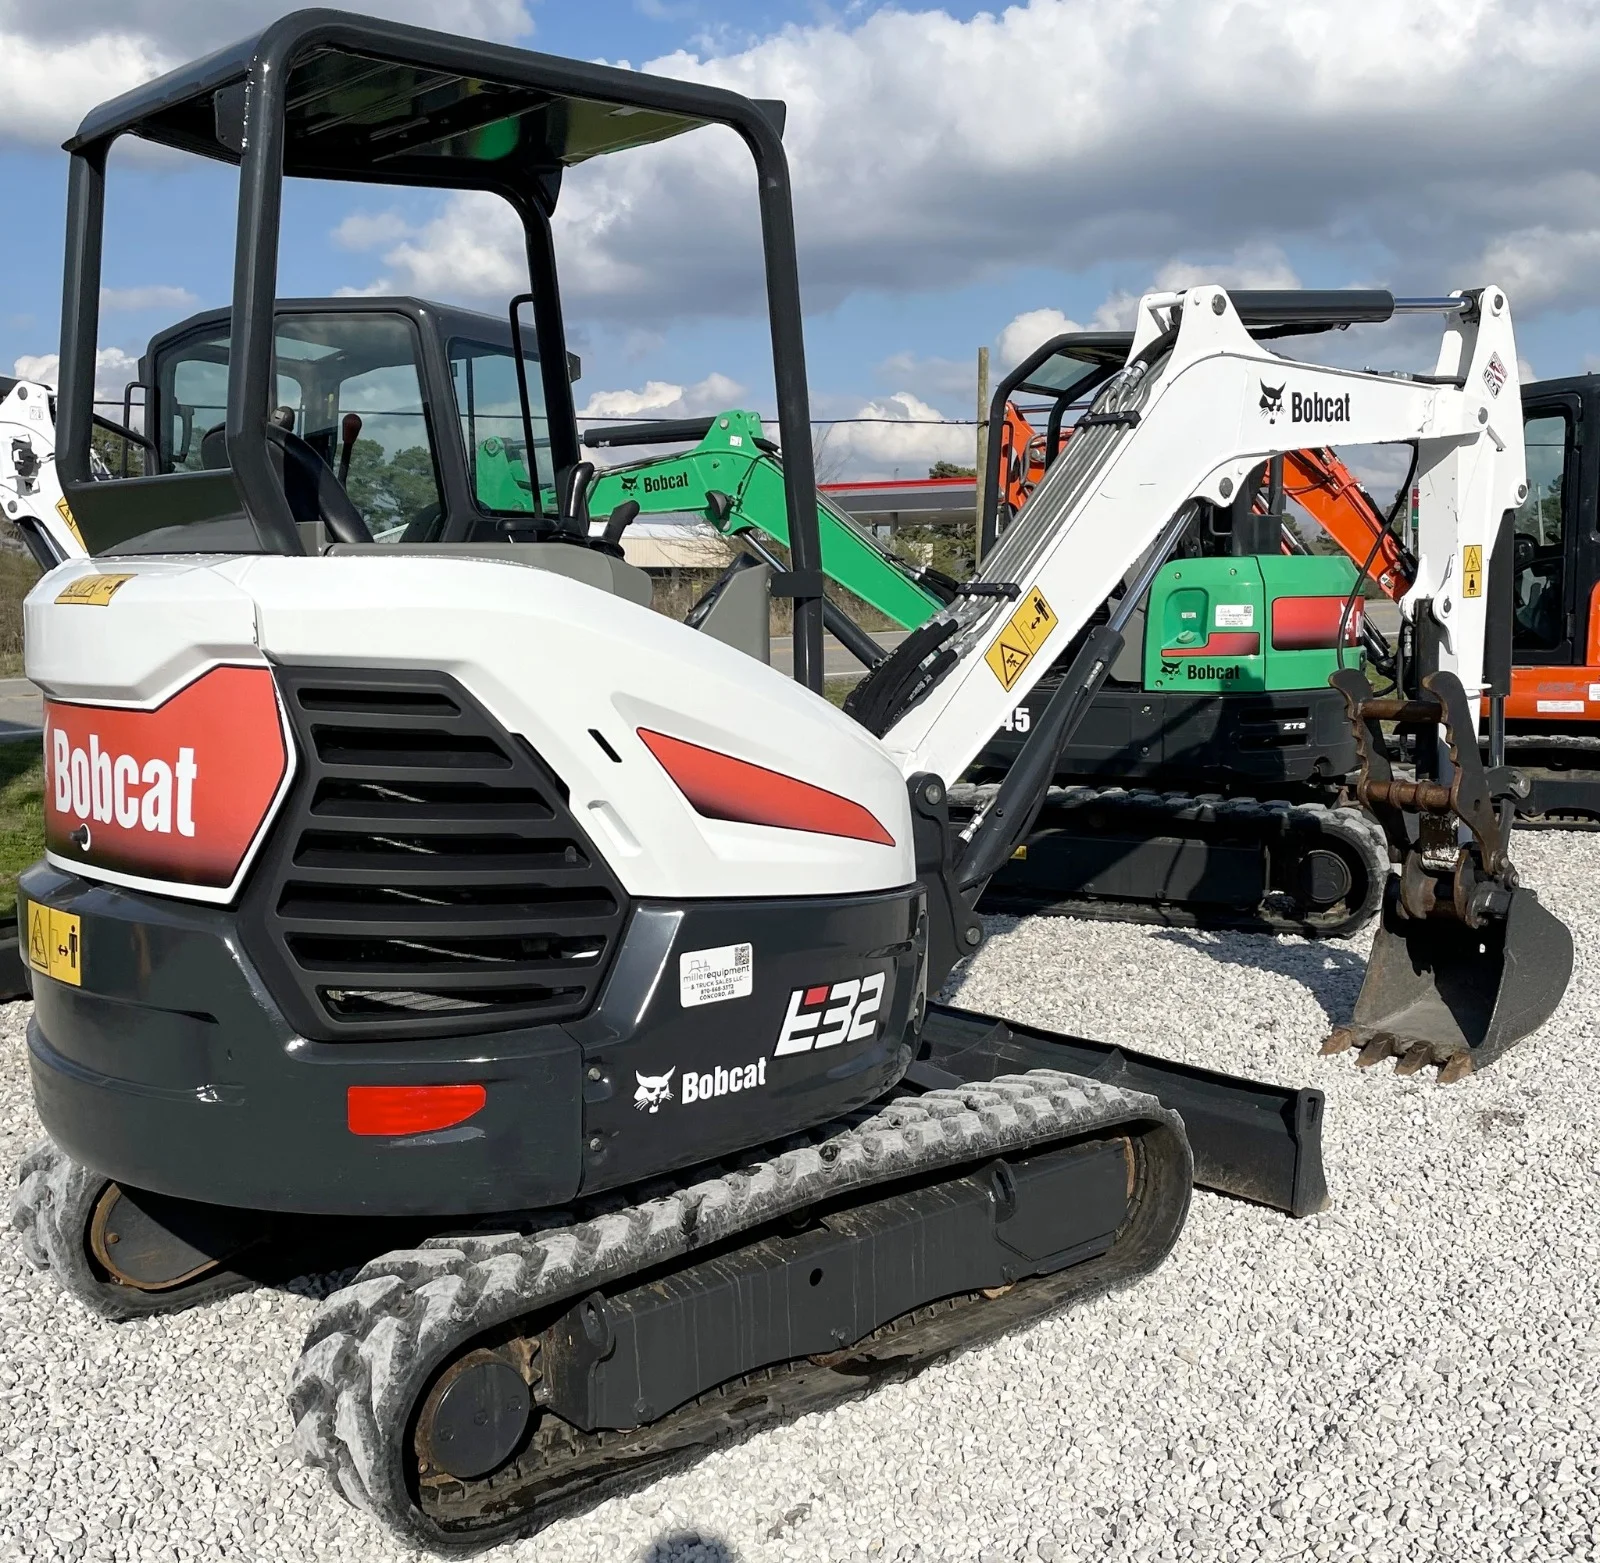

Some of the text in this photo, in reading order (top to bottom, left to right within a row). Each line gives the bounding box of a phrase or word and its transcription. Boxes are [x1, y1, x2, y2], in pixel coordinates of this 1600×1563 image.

[1291, 391, 1351, 423] Bobcat
[643, 471, 689, 493] Bobcat
[1187, 664, 1241, 680] Bobcat
[1283, 722, 1306, 730] ZTS
[53, 728, 198, 838] Bobcat
[696, 980, 714, 989] TRUCK
[715, 977, 732, 986] SALES
[773, 971, 886, 1057] E32
[681, 1056, 767, 1105] Bobcat
